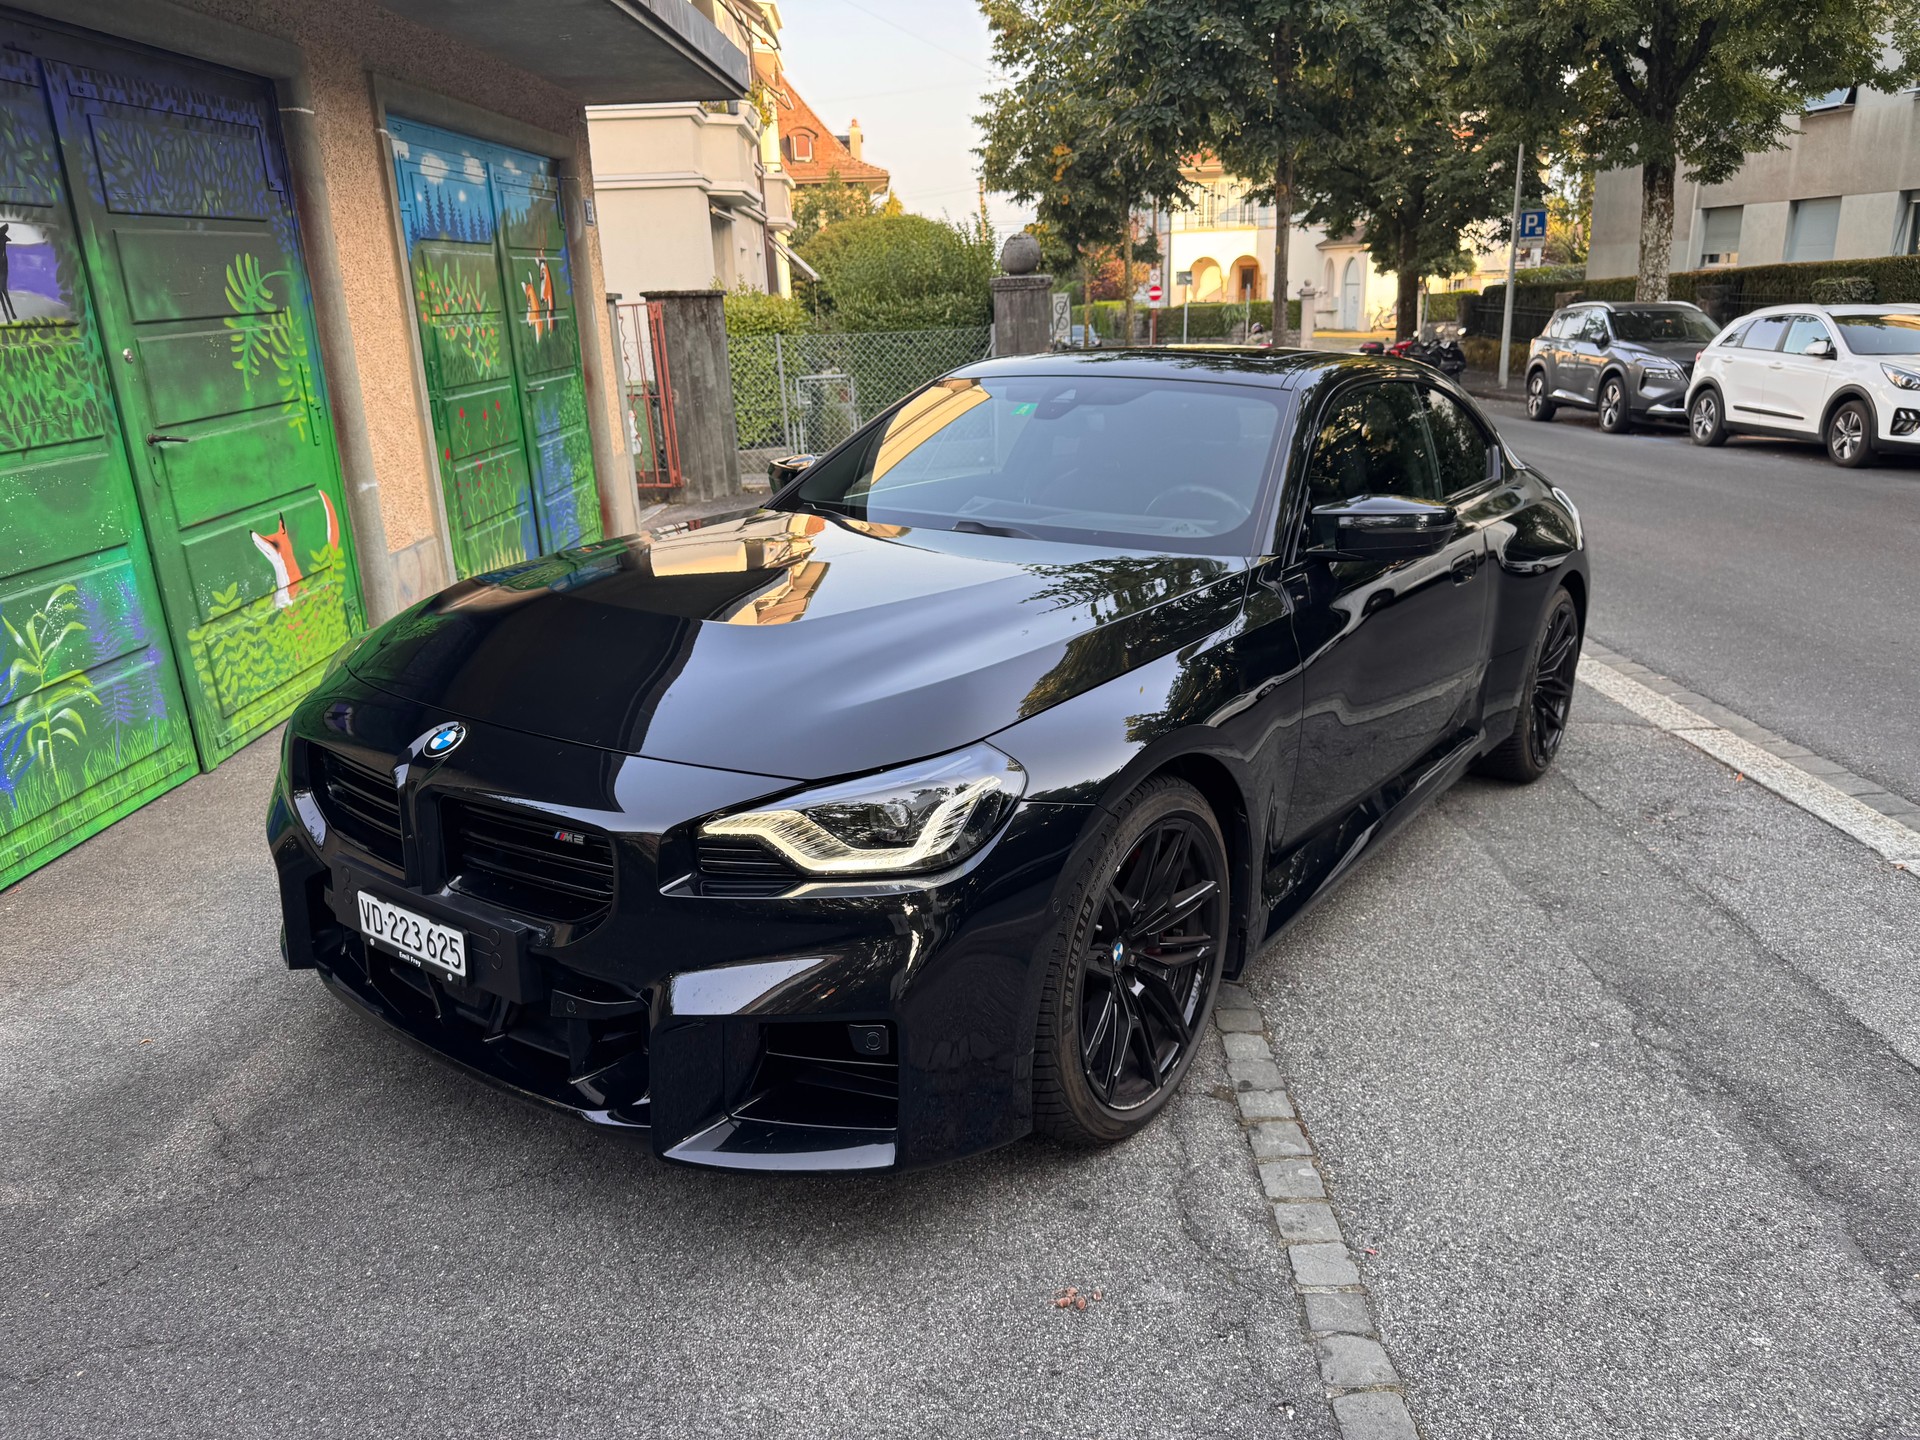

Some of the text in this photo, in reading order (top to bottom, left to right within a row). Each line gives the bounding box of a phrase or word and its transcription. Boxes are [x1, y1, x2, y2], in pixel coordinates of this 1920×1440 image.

[1525, 214, 1538, 234] P
[427, 928, 461, 969] 625
[1064, 900, 1092, 1008] MICHELIN
